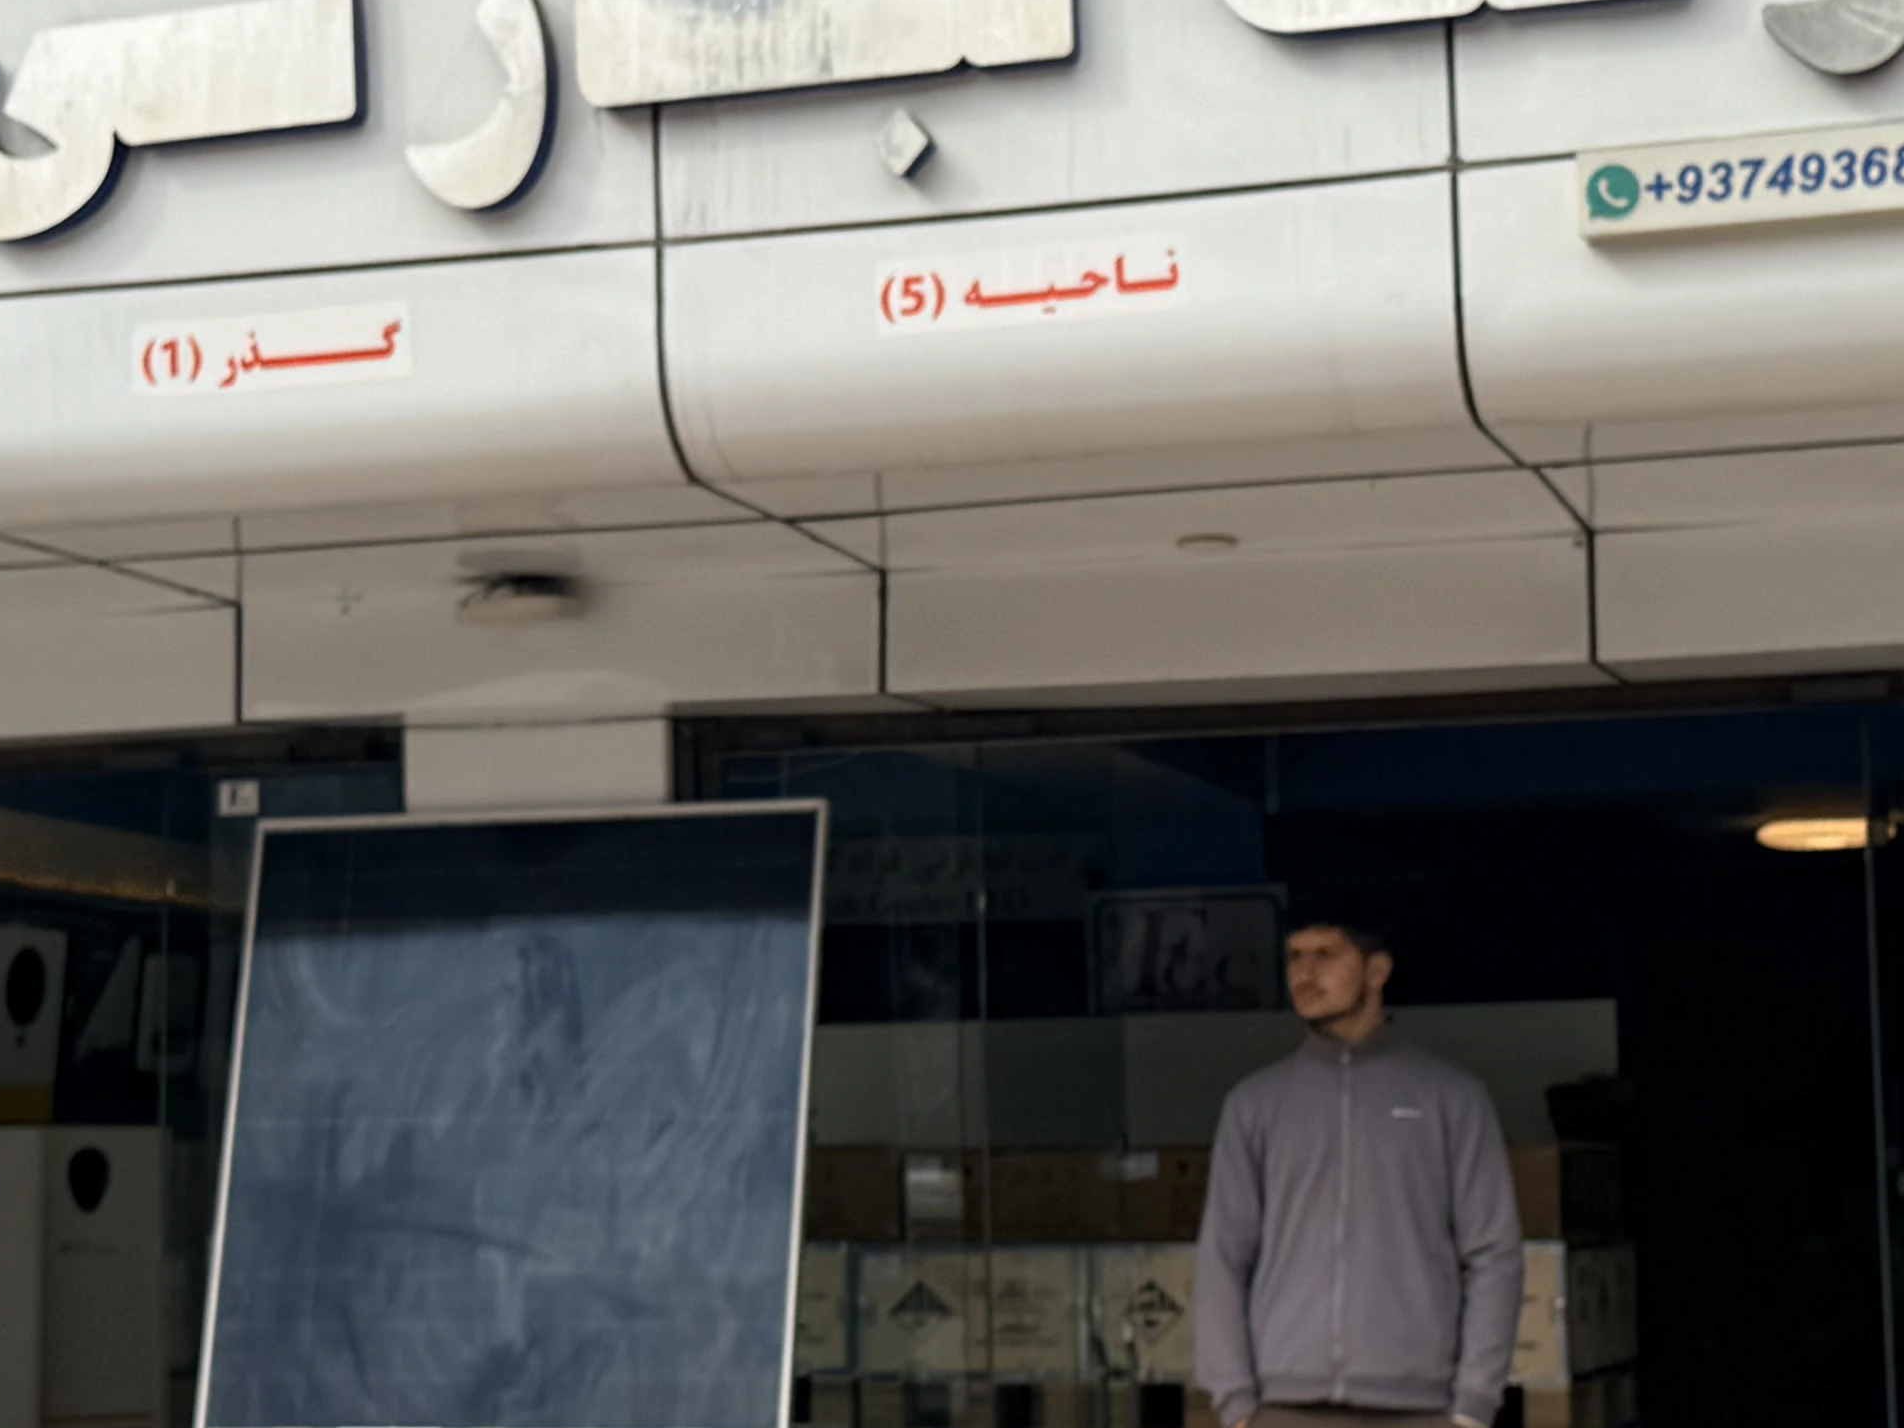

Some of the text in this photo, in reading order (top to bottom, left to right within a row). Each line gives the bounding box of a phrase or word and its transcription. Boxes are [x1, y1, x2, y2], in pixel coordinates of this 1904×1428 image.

[880, 249, 1179, 323] ناحیه (5)
[142, 319, 401, 389] گذر (1)
